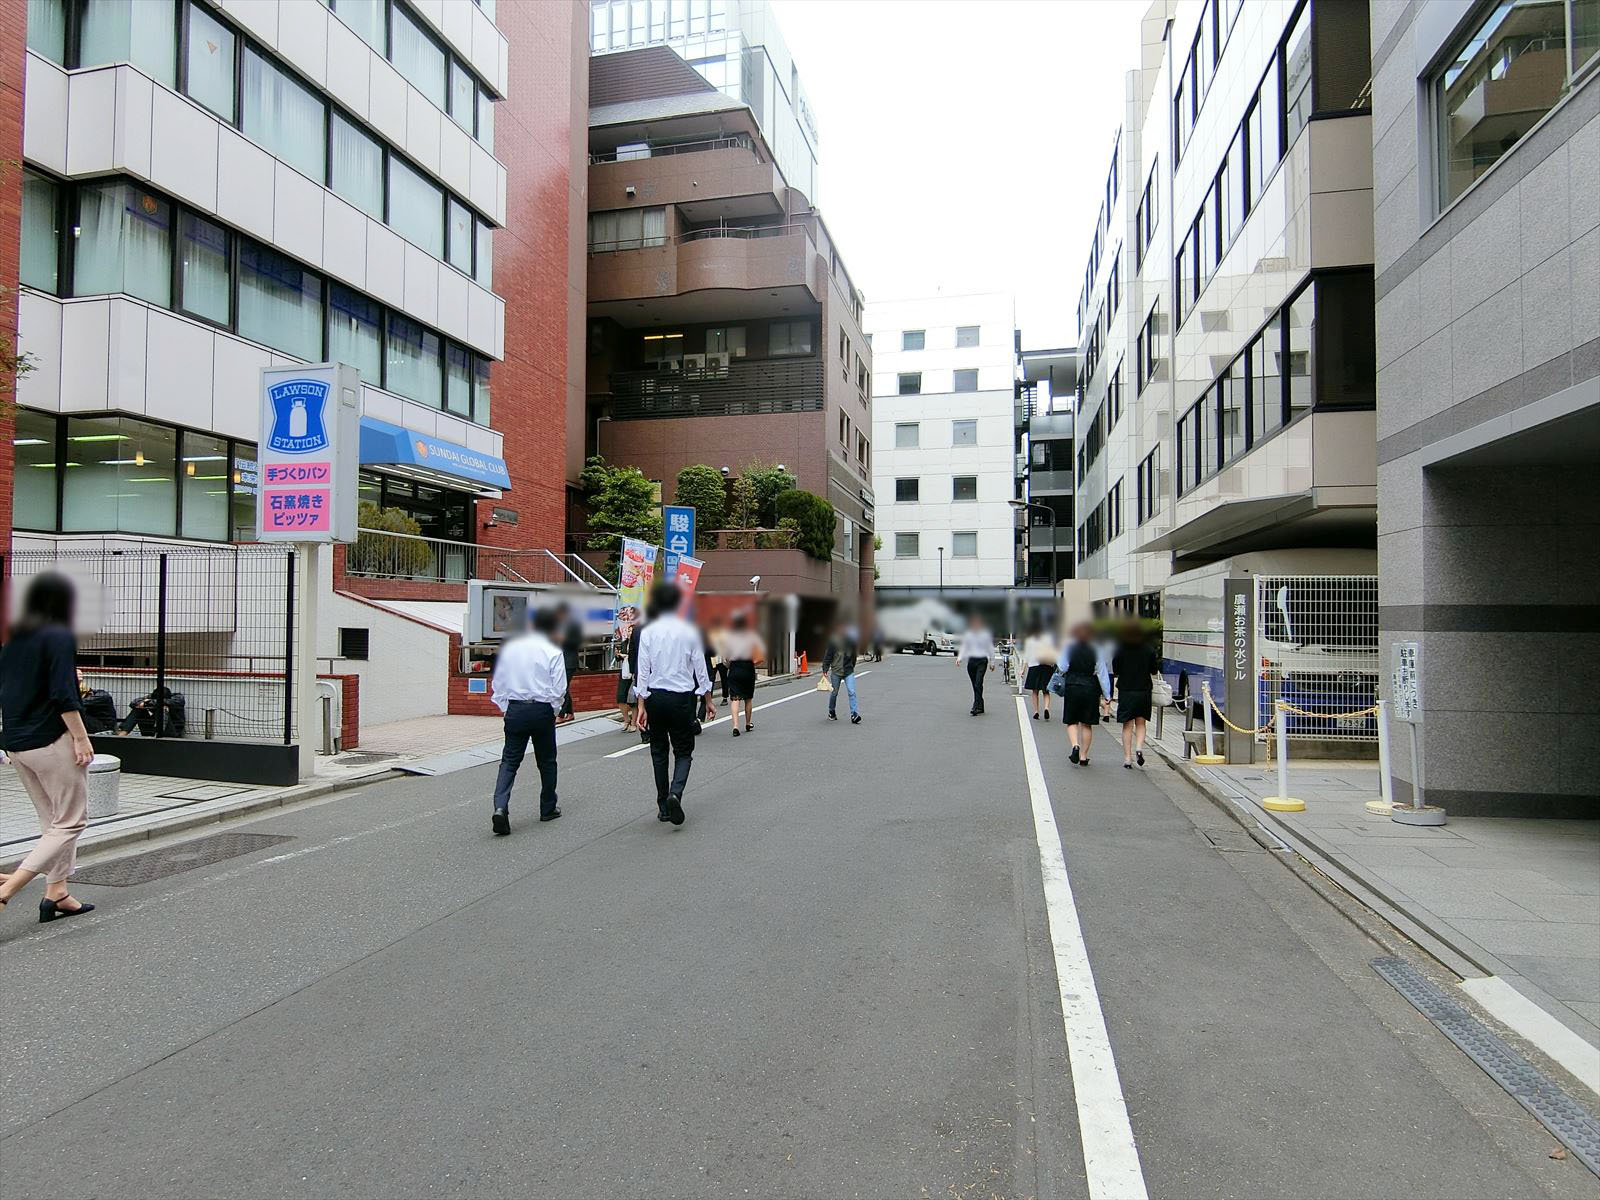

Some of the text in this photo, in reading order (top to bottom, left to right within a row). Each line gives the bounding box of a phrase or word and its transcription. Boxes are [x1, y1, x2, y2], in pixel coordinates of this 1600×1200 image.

[273, 384, 324, 399] LAWSON
[273, 435, 322, 449] STATION
[429, 444, 460, 462] SUNDAI
[460, 454, 488, 472] GLOBAL
[488, 462, 506, 476] CLUB
[267, 467, 327, 481] 手づくりパン
[270, 494, 323, 510] 石窯焼き
[273, 512, 319, 526] ピッツァ
[669, 513, 690, 553] 駿台
